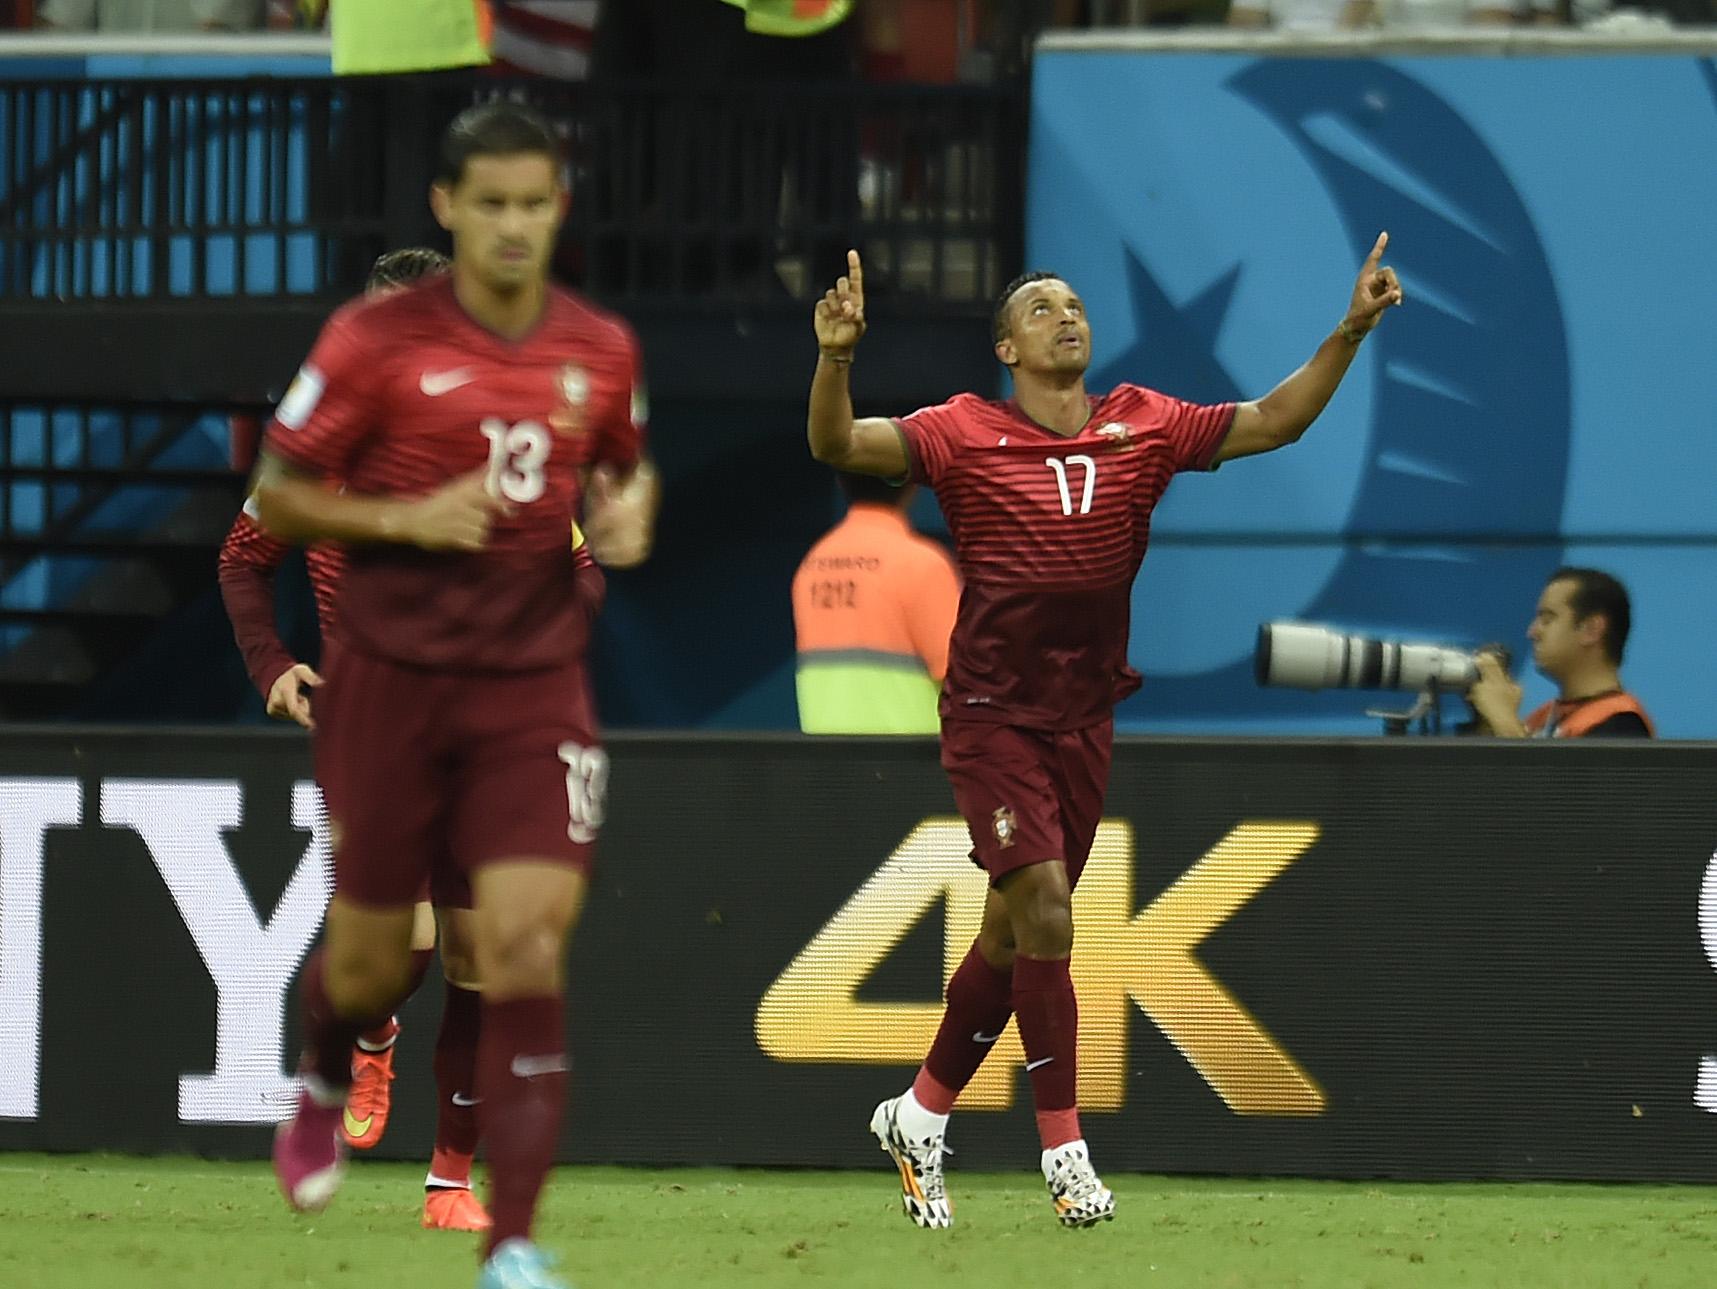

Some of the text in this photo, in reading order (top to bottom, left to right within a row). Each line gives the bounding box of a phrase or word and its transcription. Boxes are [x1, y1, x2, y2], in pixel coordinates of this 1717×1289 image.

[480, 418, 551, 502] 13
[1046, 455, 1096, 515] 17
[558, 741, 609, 844] 13
[756, 820, 1327, 1114] 4K
